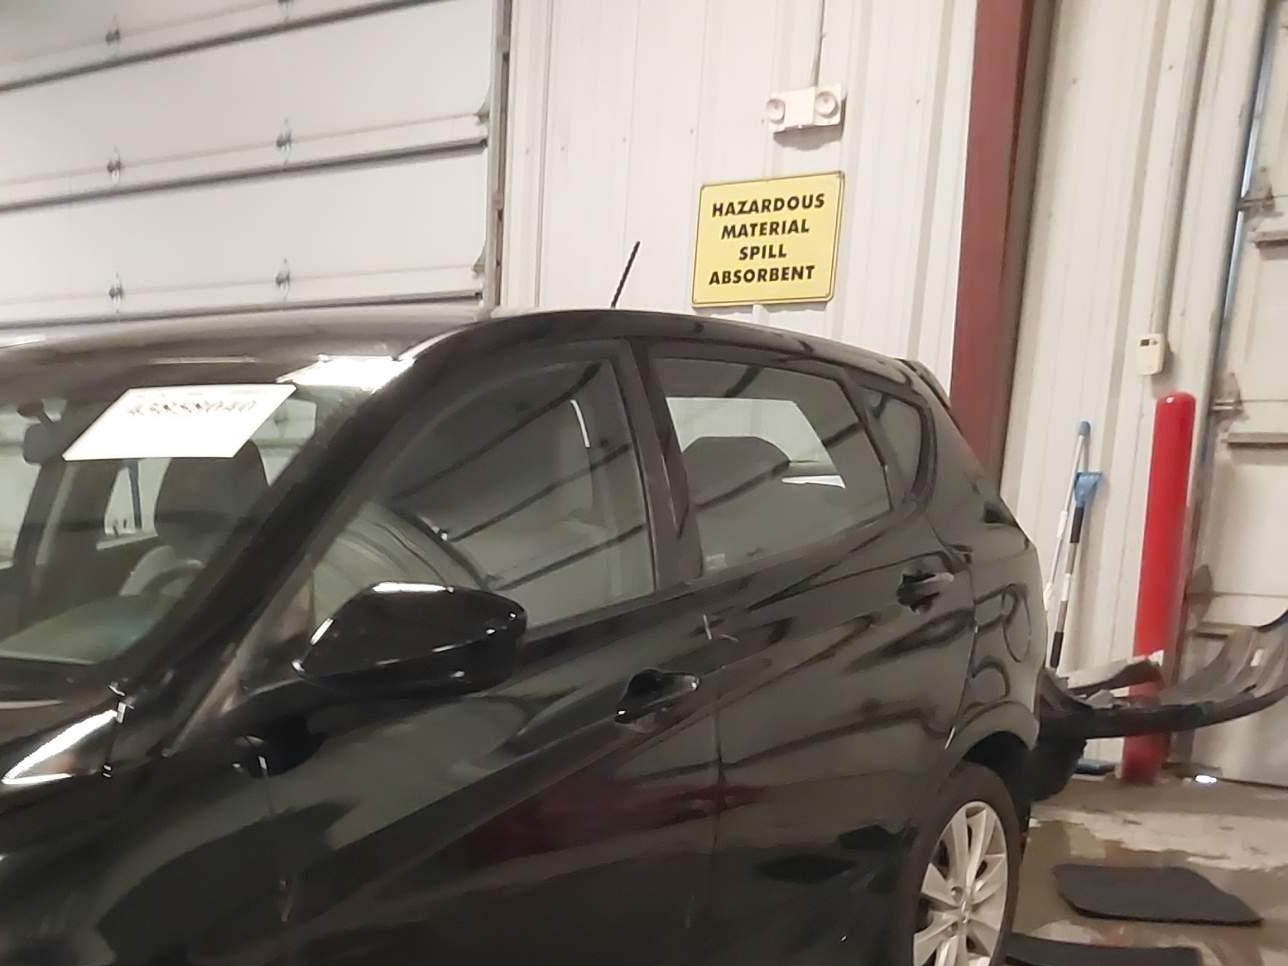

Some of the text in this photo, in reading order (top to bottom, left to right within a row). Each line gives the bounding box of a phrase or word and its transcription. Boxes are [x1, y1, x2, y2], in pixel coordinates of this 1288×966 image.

[712, 193, 825, 217] HAZARDOUS
[721, 219, 810, 240] MATERIAL
[739, 244, 787, 261] SPILL
[709, 265, 815, 285] ABSORBENT
